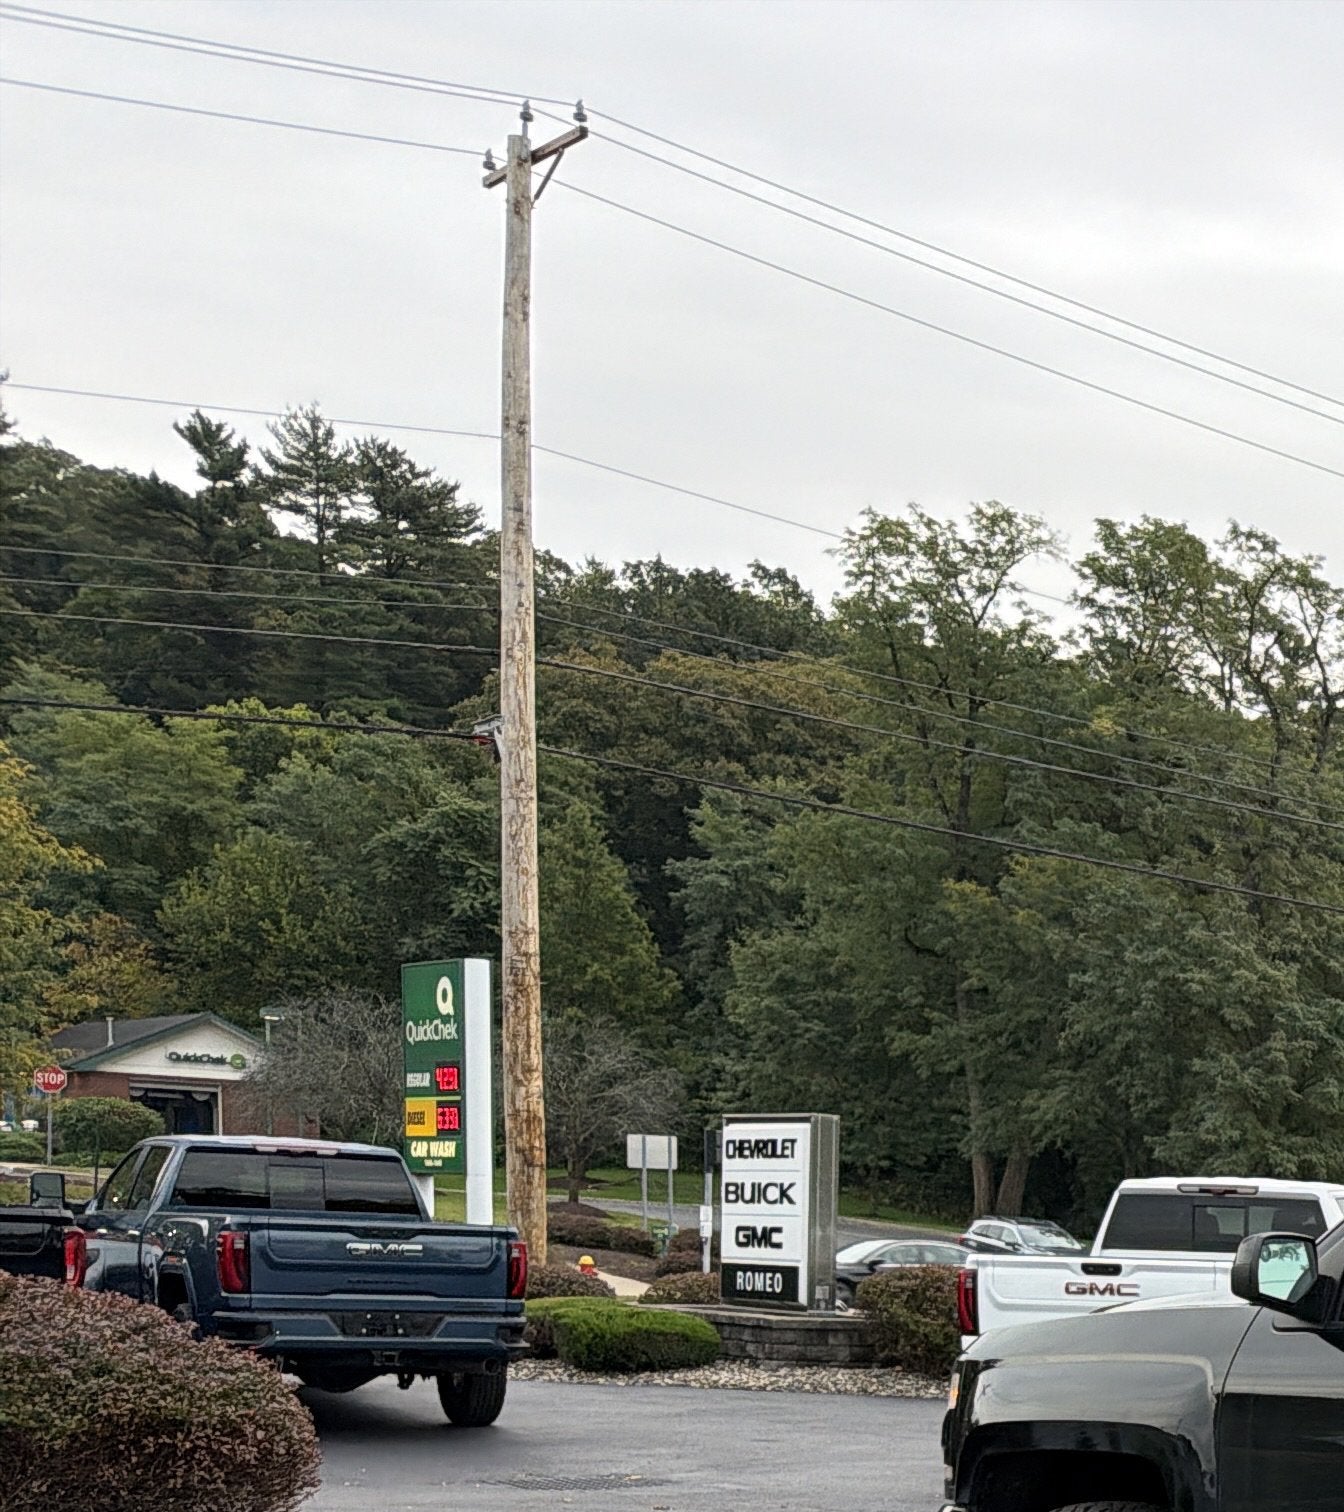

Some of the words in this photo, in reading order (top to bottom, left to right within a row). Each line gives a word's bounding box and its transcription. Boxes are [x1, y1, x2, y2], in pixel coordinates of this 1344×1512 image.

[436, 976, 454, 1015] Q
[406, 1018, 458, 1045] QuickChek
[36, 1072, 66, 1086] STOP
[410, 1140, 428, 1158] CAR
[429, 1140, 456, 1158] WASH
[725, 1138, 798, 1159] CHEVROLET
[724, 1182, 797, 1206] BUICK
[735, 1225, 783, 1250] GMC
[345, 1242, 423, 1257] GMC
[736, 1271, 783, 1294] ROMEO
[1064, 1281, 1141, 1298] GMC
